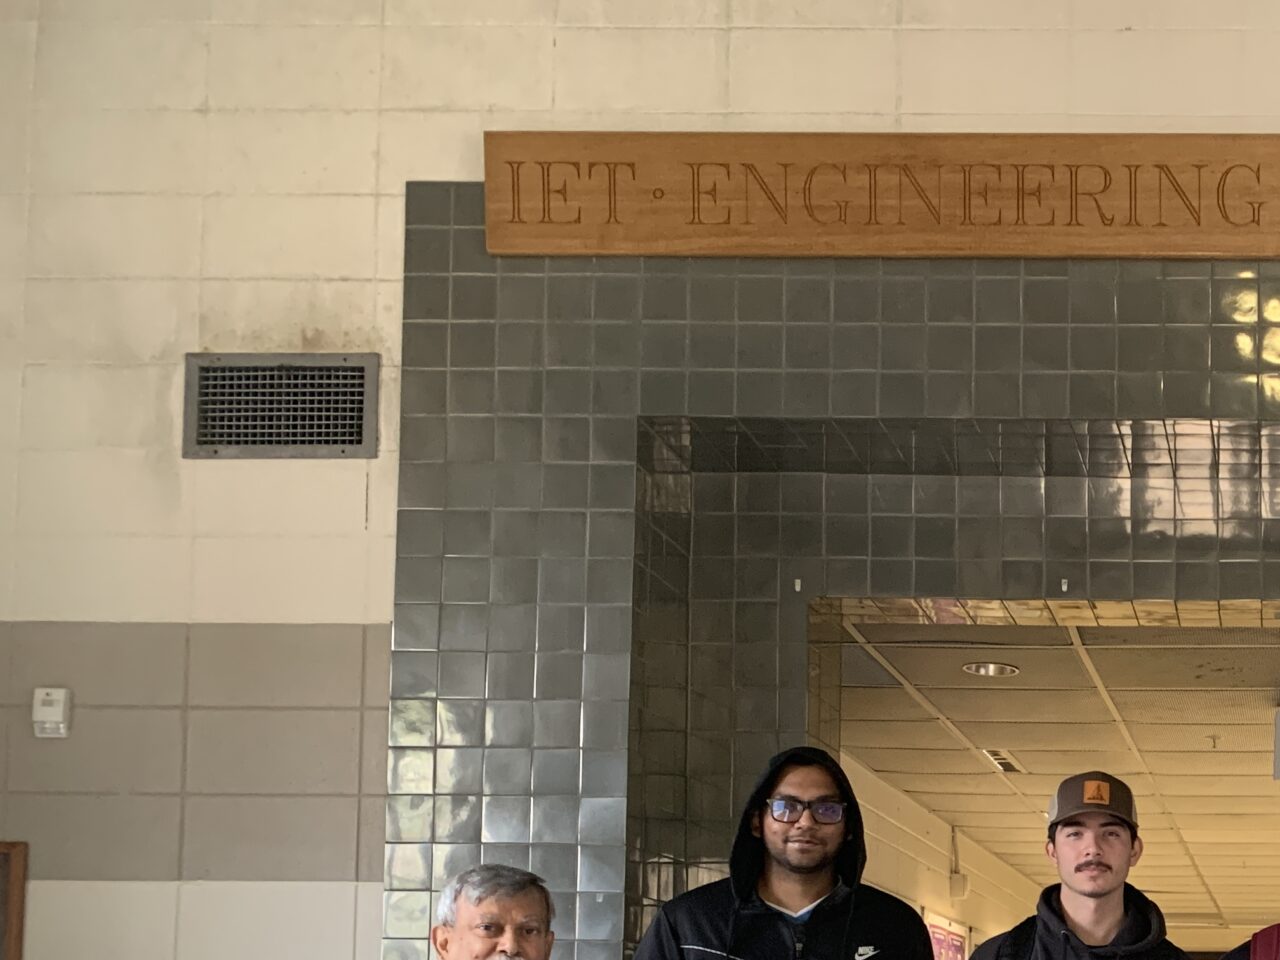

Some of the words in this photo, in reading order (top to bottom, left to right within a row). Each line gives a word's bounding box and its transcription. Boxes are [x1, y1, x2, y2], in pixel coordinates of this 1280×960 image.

[504, 160, 637, 226] IET
[685, 161, 1267, 228] ENGINEERING
[858, 945, 875, 955] NIKE
